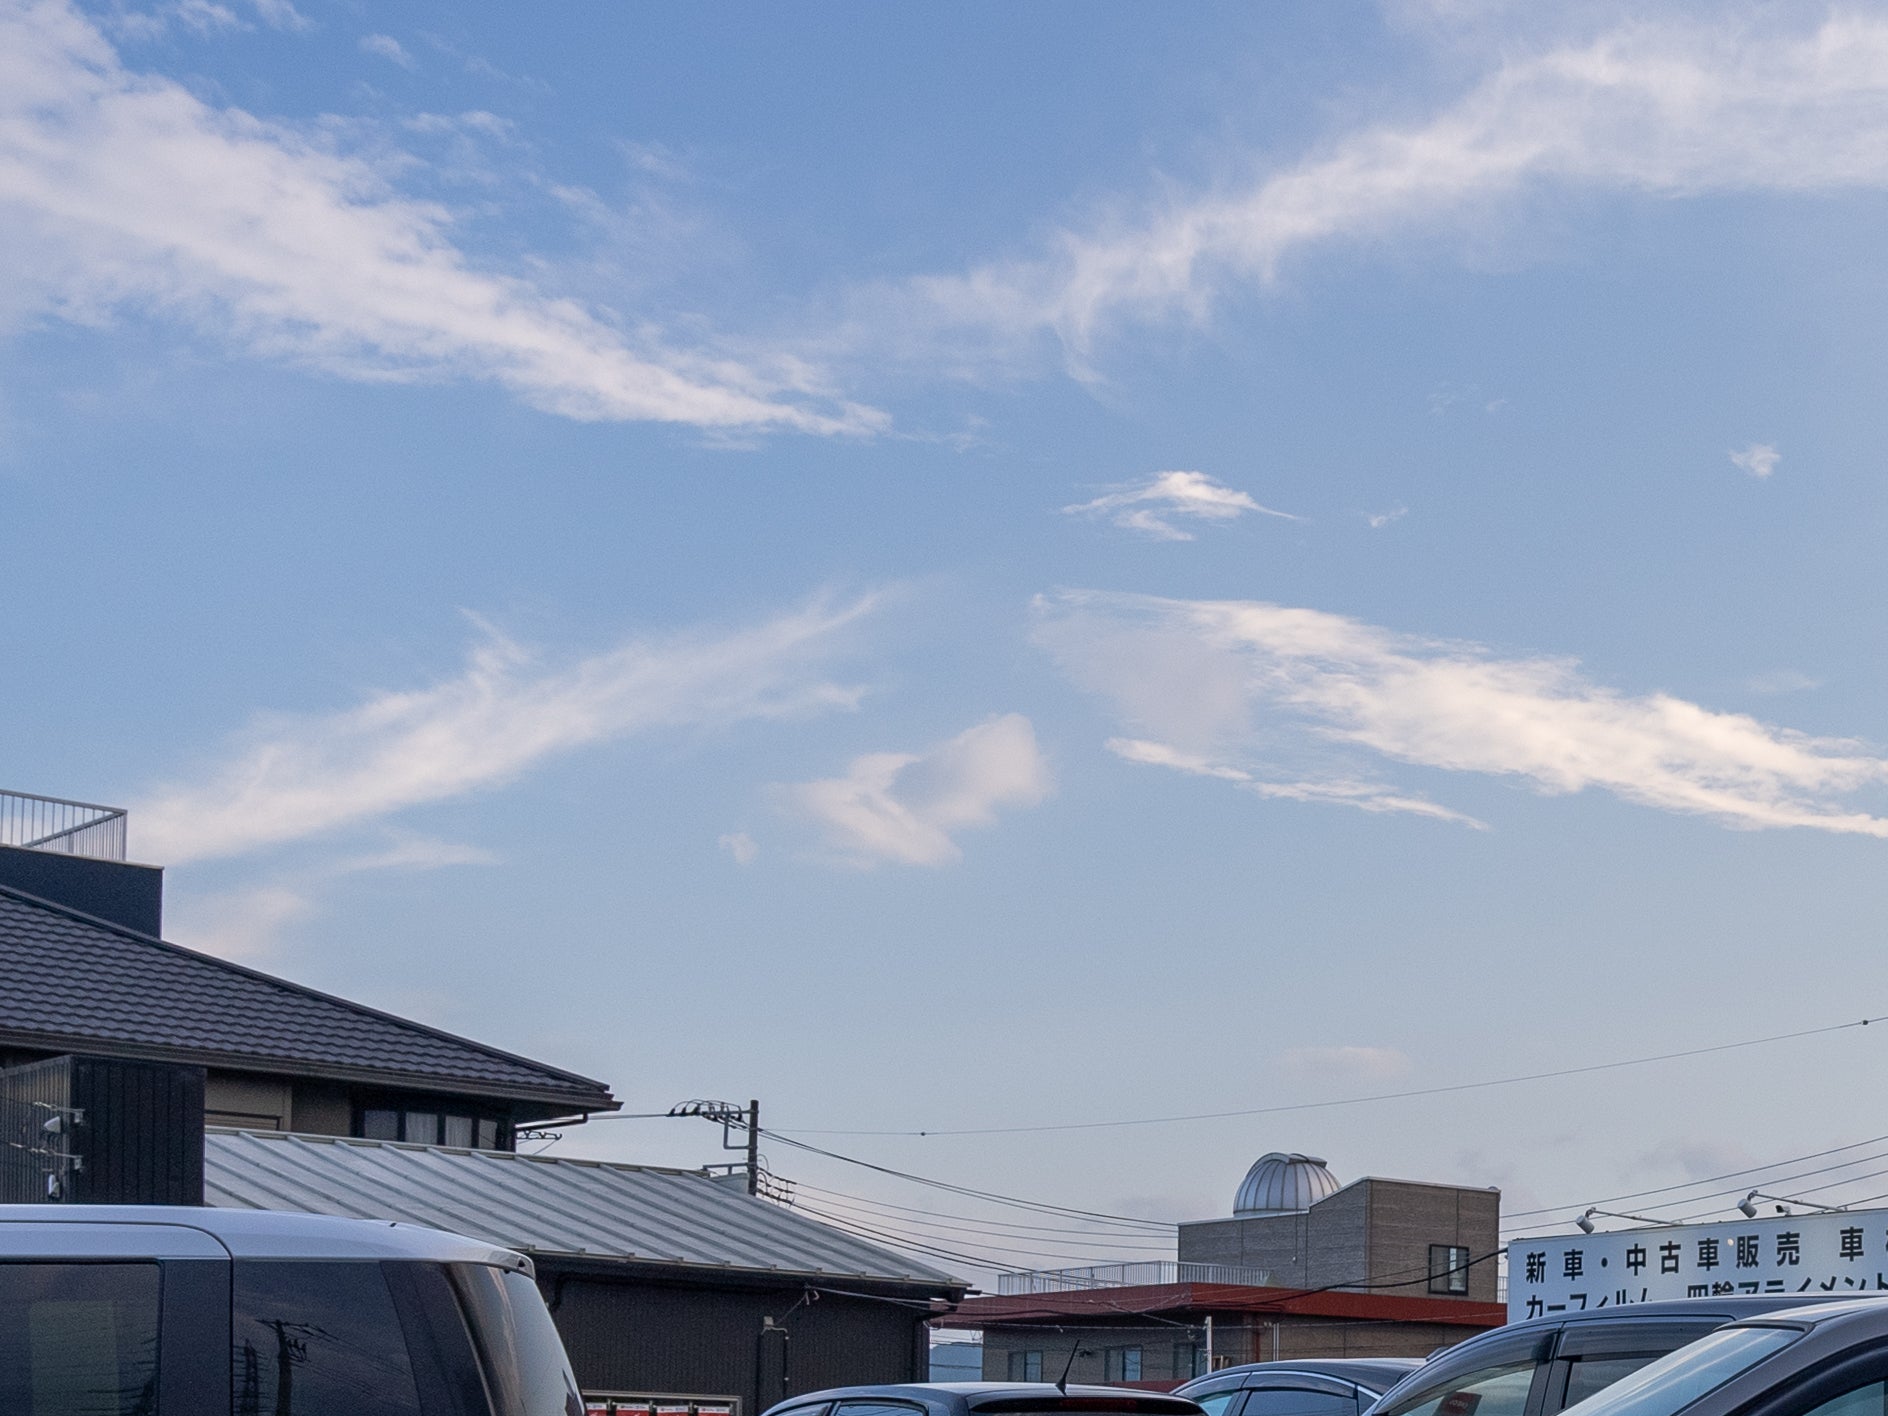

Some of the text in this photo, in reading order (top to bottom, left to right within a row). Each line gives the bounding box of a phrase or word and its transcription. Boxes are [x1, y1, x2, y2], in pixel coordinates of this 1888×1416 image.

[1526, 1231, 1801, 1284] 新車・中古車販売
